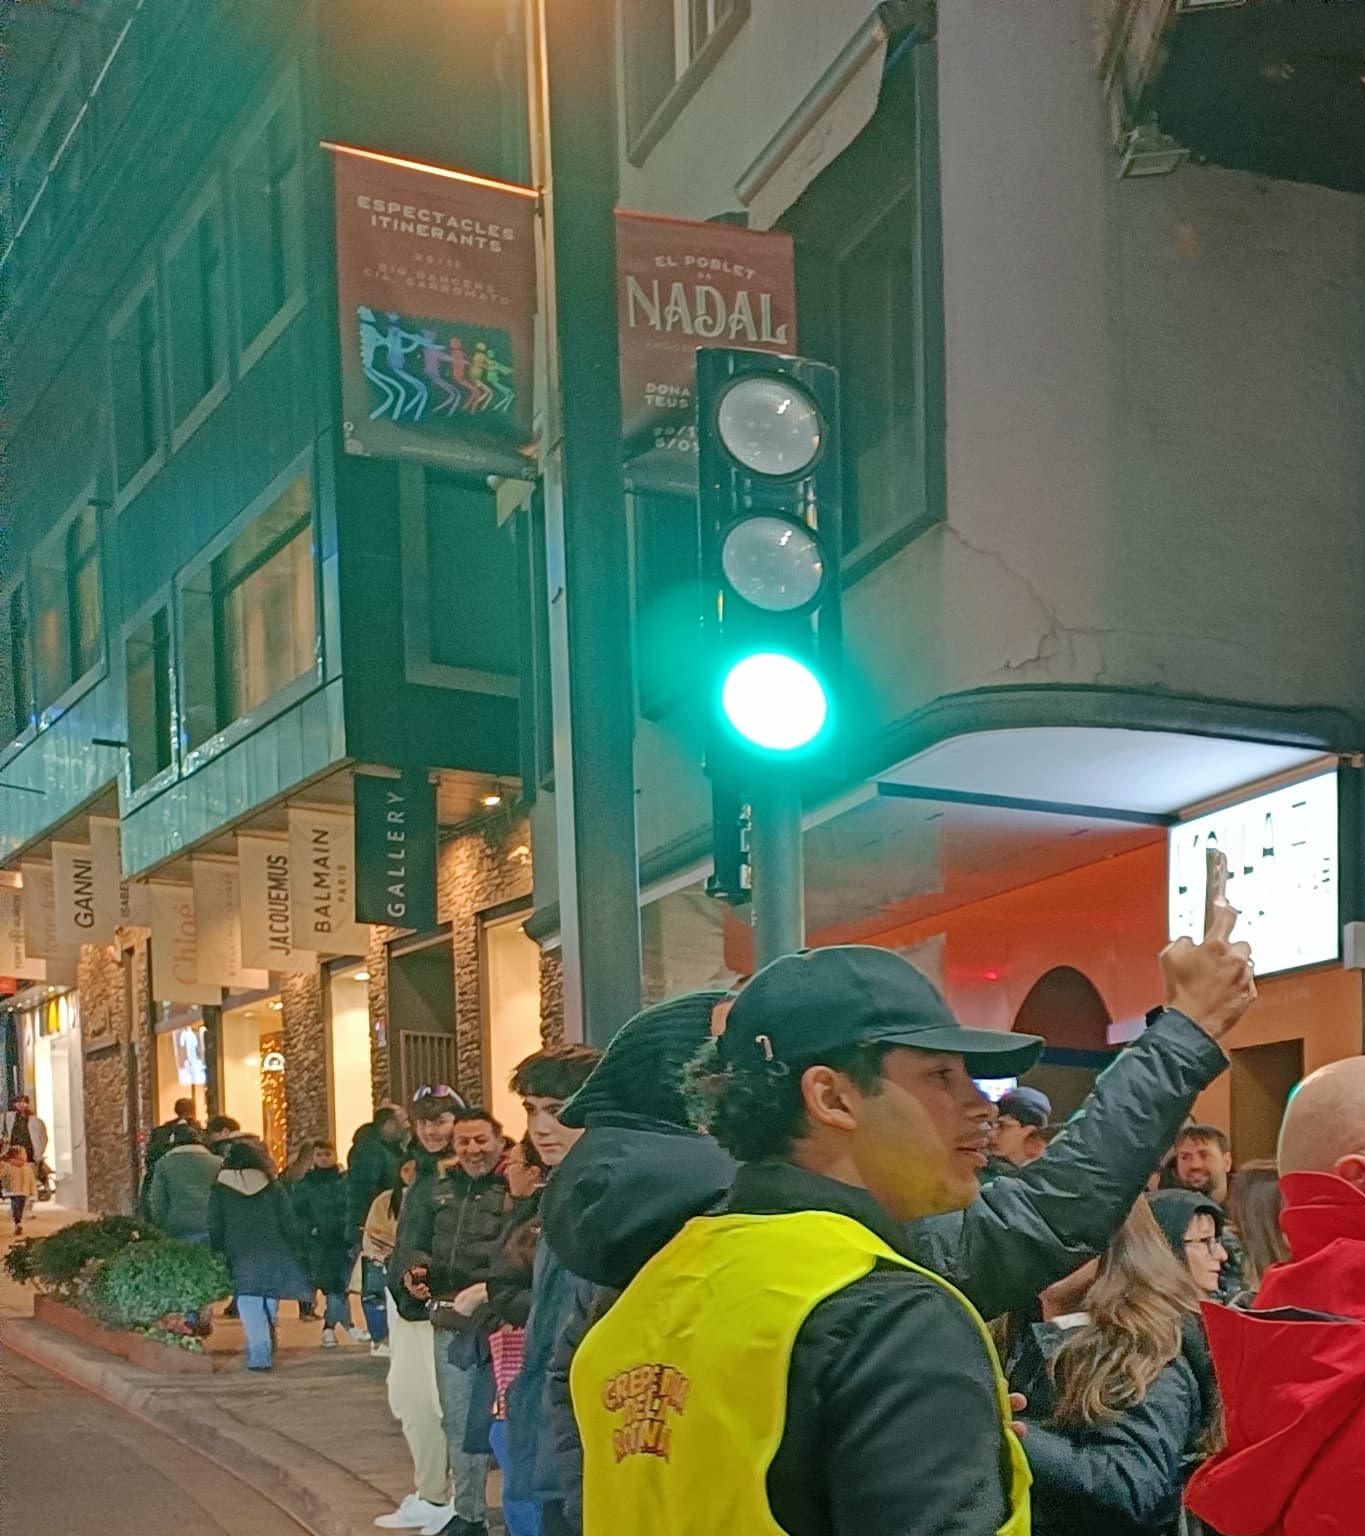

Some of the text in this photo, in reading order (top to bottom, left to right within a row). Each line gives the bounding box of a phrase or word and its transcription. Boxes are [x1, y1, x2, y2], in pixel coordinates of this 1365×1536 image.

[357, 195, 515, 241] ESPECTACLES
[371, 214, 502, 253] ITINERANTS
[655, 255, 756, 280] EL POBLET
[626, 275, 789, 345] NADAL
[644, 394, 689, 409] TEUS
[645, 382, 691, 397] DONA
[387, 791, 406, 918] GALLERY
[72, 858, 96, 929] GANNI
[312, 829, 332, 934] BALMAIN
[337, 863, 348, 903] PARIS
[266, 854, 291, 956] JACQUEMUS
